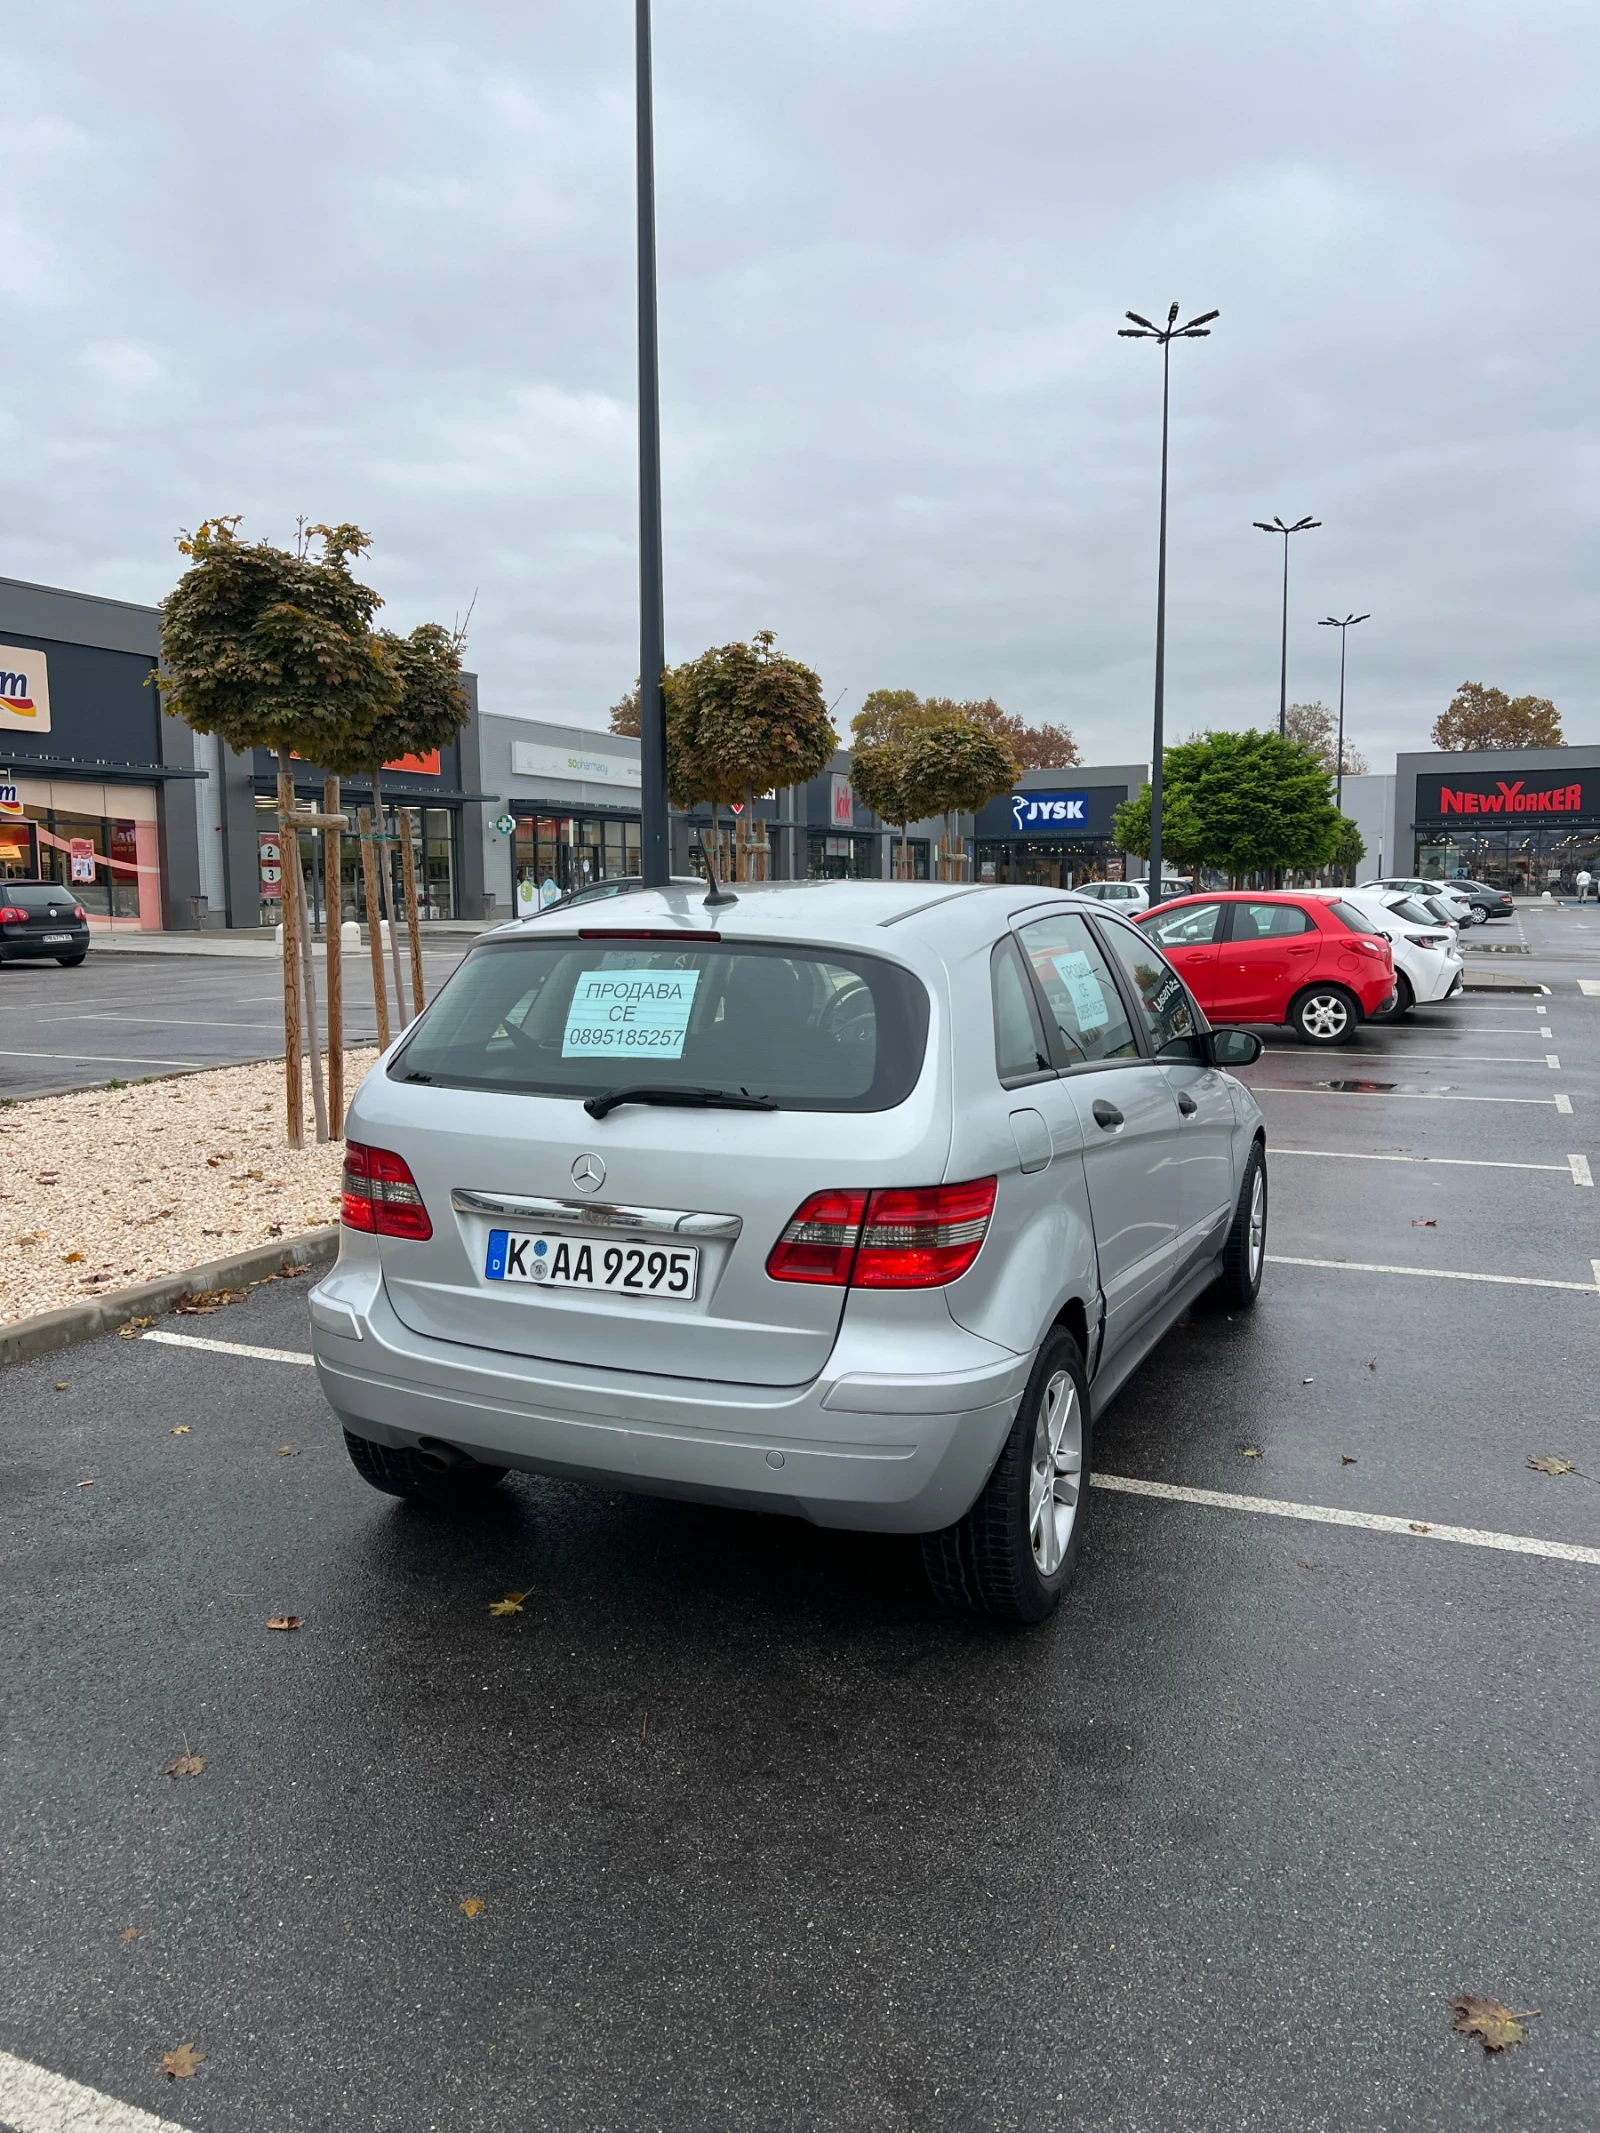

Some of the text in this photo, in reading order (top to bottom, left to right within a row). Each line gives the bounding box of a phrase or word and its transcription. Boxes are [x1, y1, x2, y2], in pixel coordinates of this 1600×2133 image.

[1026, 800, 1084, 820] JYSK
[267, 846, 274, 858] 2
[268, 869, 275, 881] 3
[586, 983, 682, 1002] ПРОДАВА
[608, 1005, 637, 1022] СЕ
[569, 1028, 685, 1046] 0895185257
[492, 1259, 500, 1270] D
[507, 1238, 691, 1292] K AA 9295
